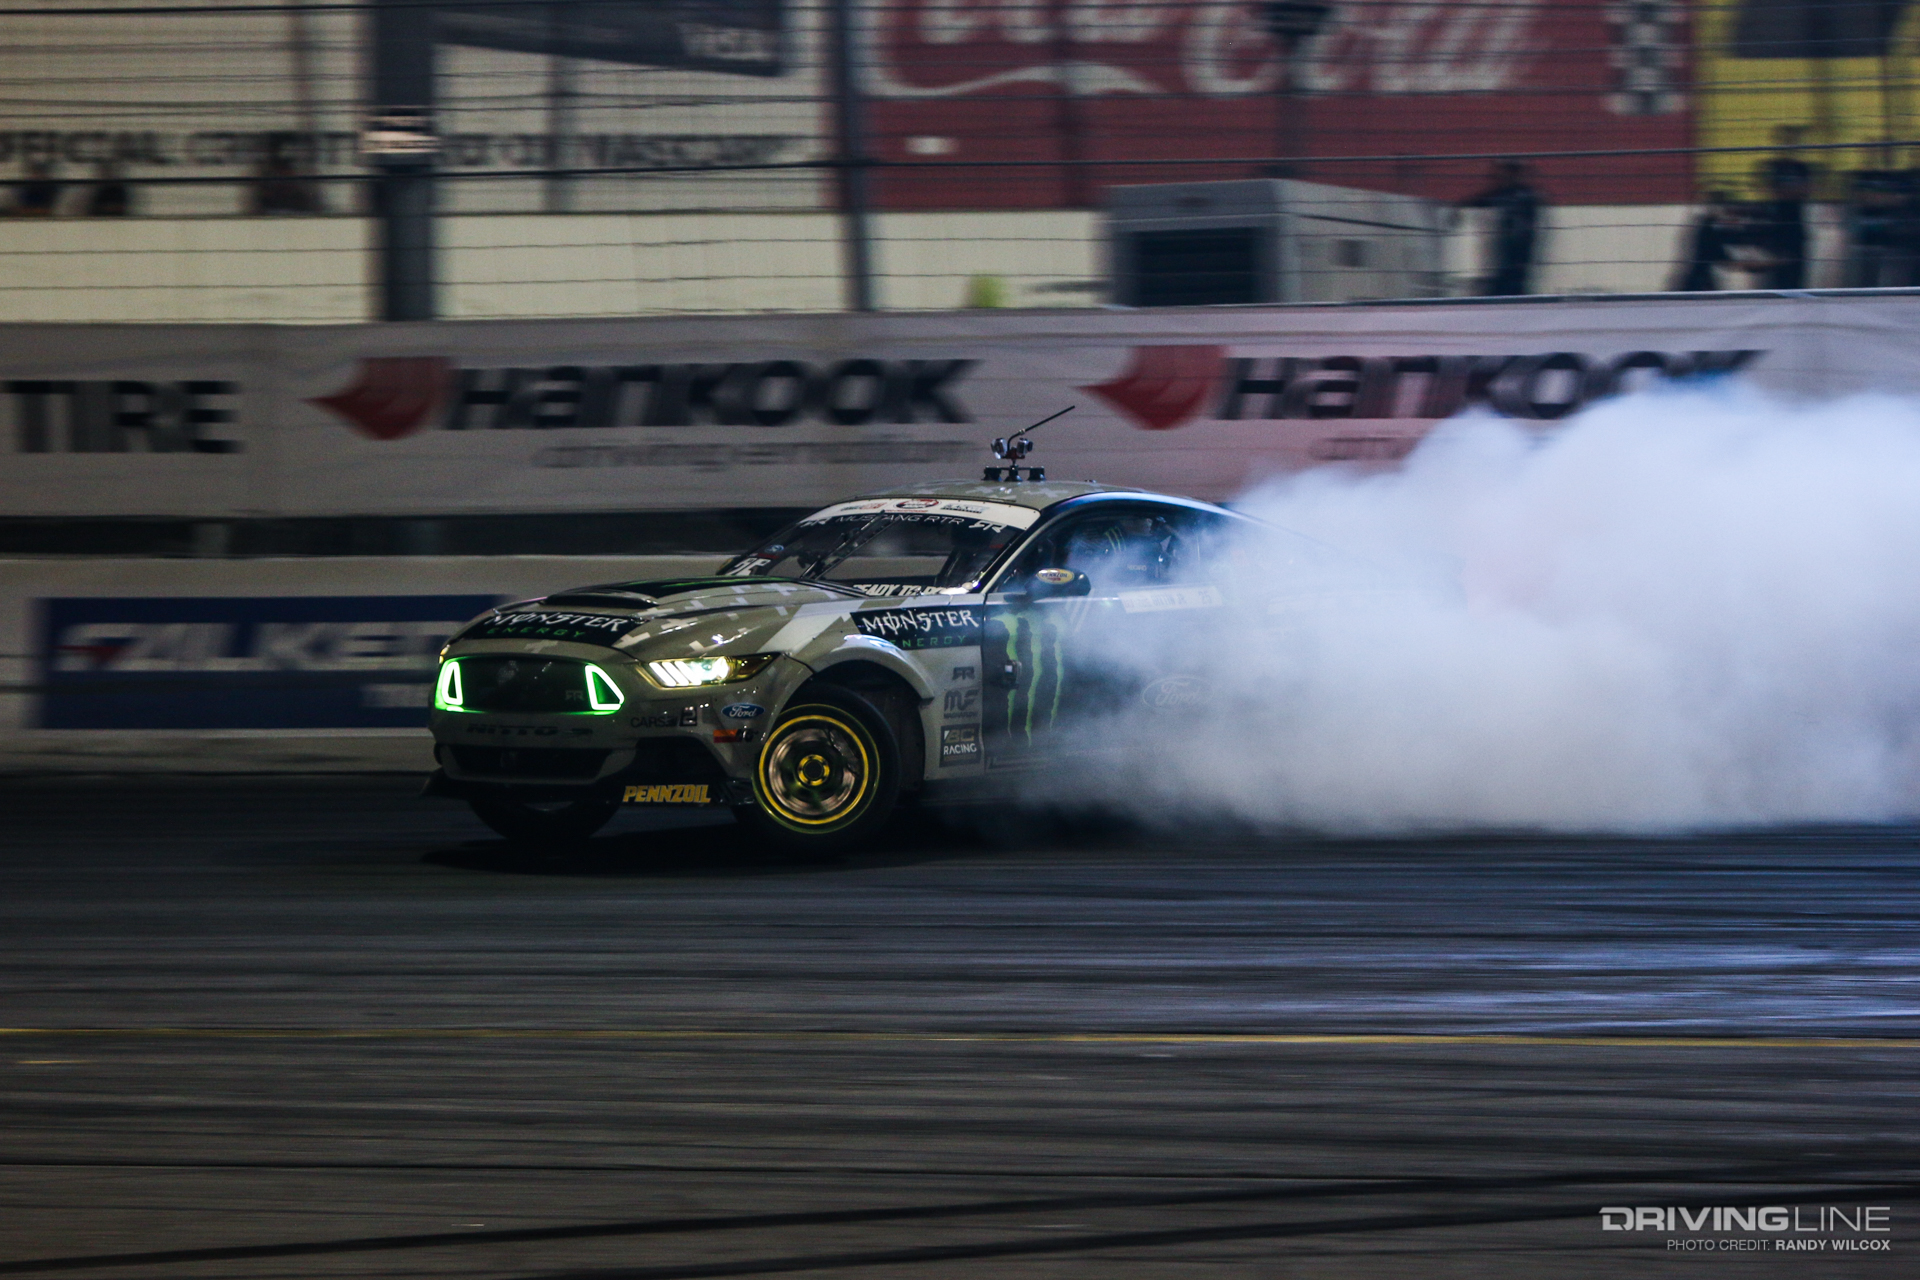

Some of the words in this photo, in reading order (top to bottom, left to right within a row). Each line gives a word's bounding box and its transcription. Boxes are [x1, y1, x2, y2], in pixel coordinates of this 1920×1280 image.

[3, 379, 245, 453] TIRE
[860, 609, 980, 636] MONSTER
[486, 626, 587, 638] ENERGY
[729, 705, 758, 718] Ford
[943, 743, 977, 755] RACING
[622, 784, 712, 803] PENNZOIL
